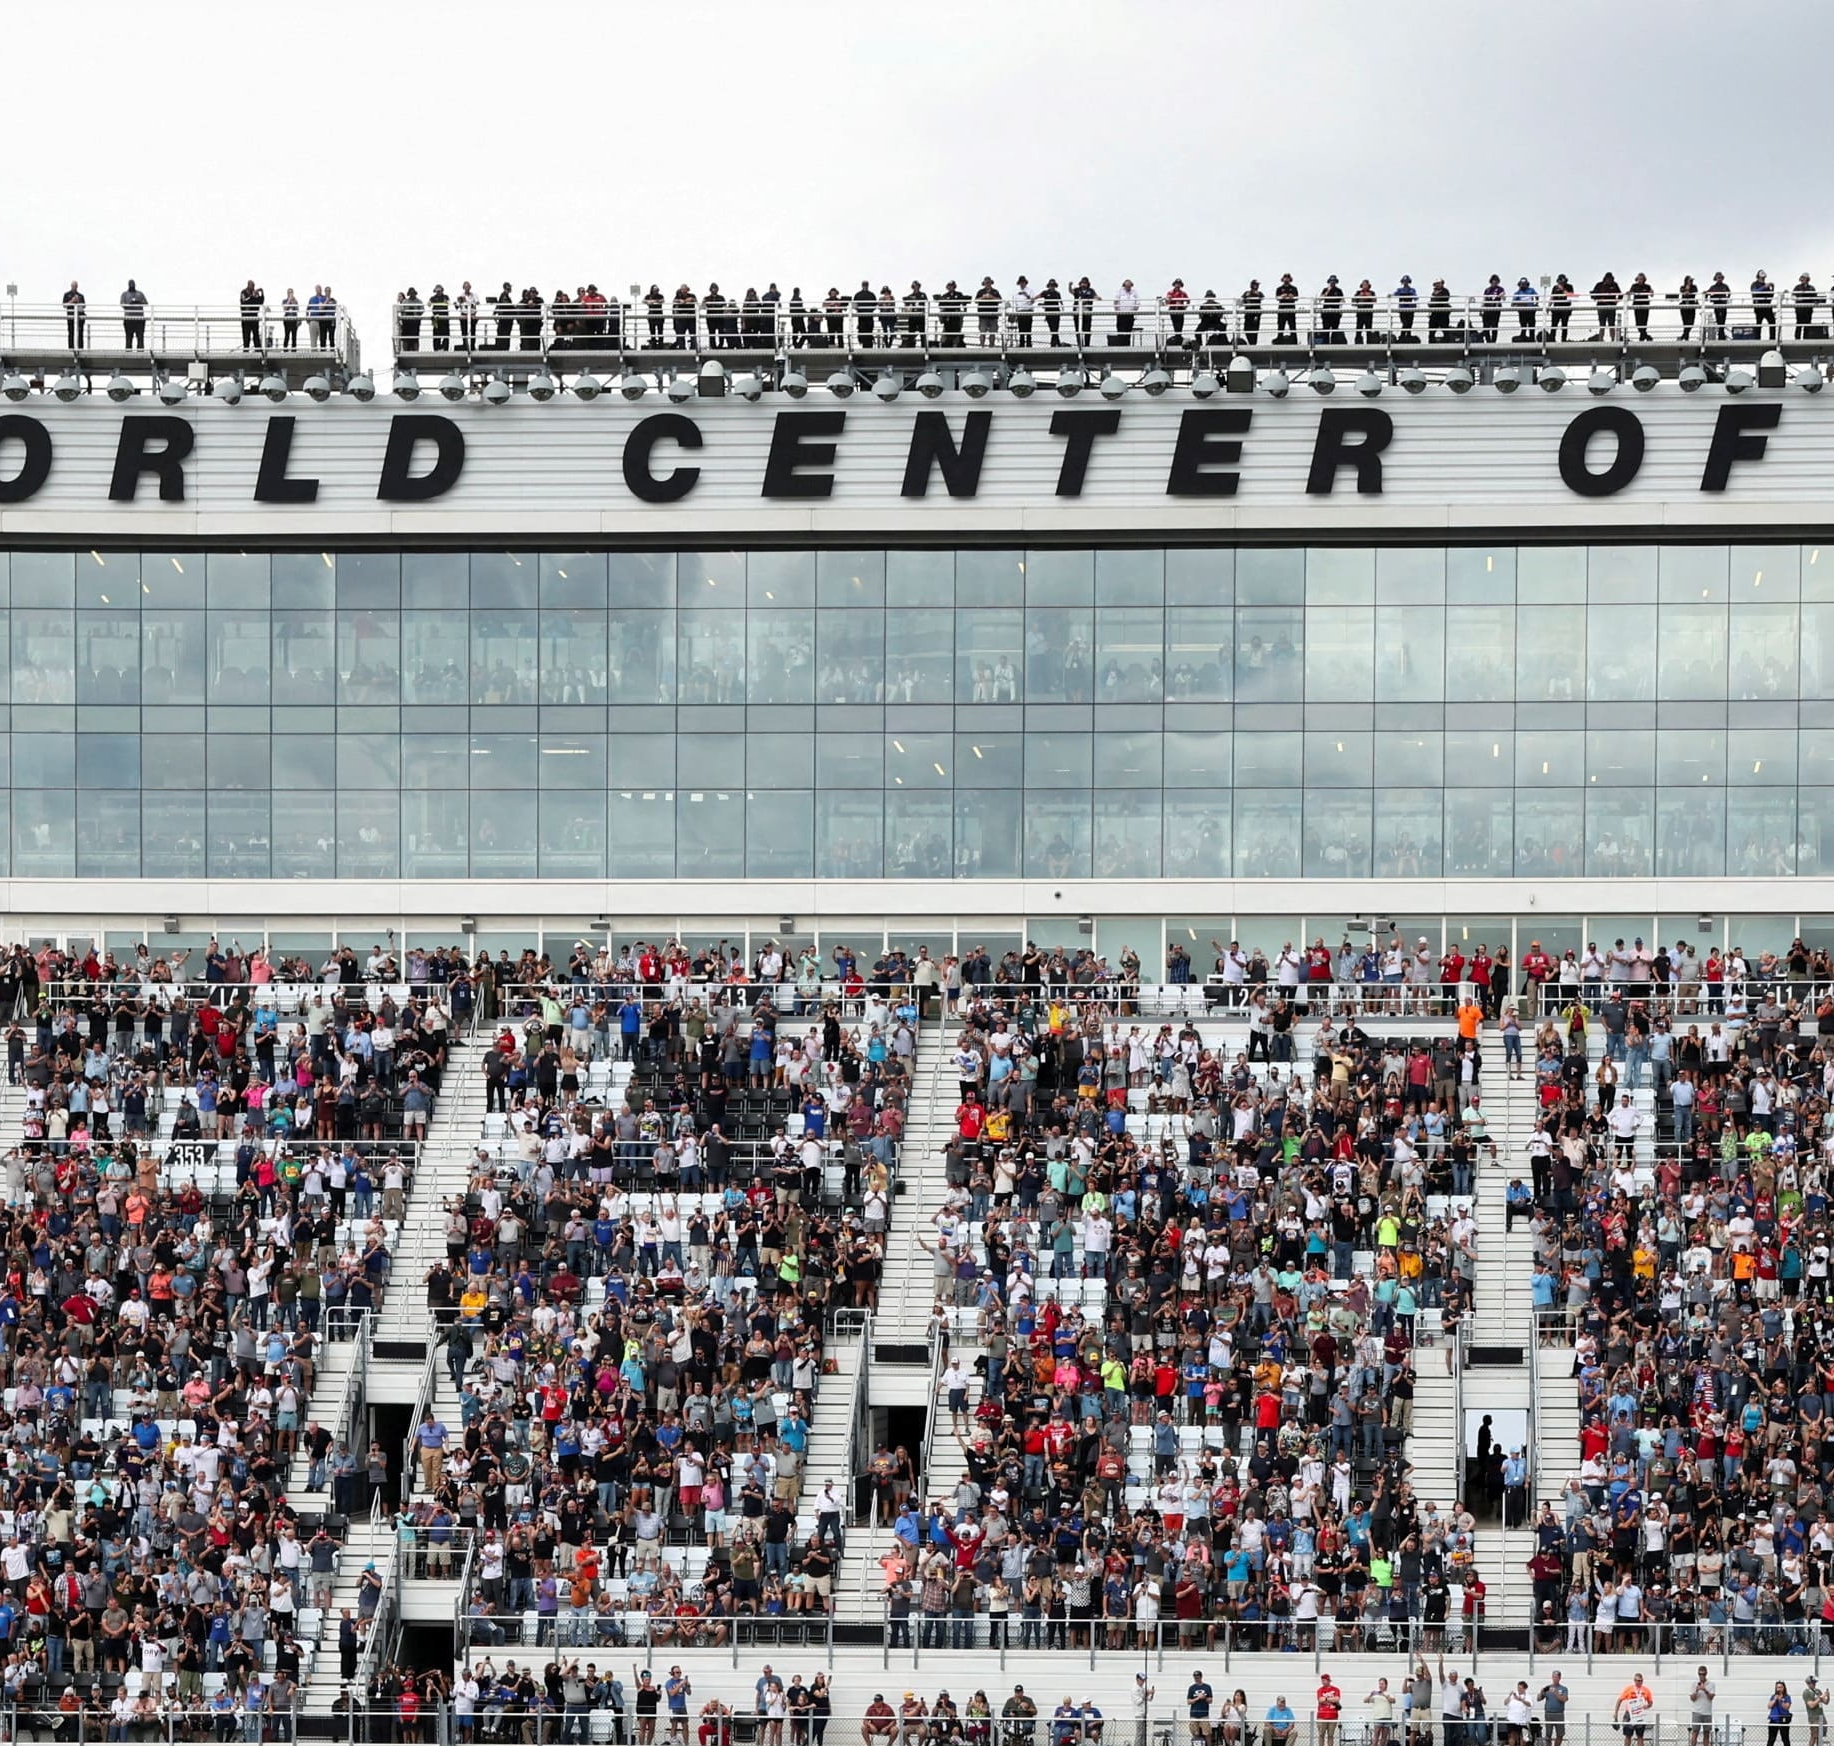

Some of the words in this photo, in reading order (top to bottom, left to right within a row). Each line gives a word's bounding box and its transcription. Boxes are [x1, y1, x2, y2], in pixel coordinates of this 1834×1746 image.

[623, 408, 1395, 501] CENTER
[1559, 404, 1783, 498] OF
[1228, 988, 1250, 1010] L2
[174, 1145, 205, 1166] 353
